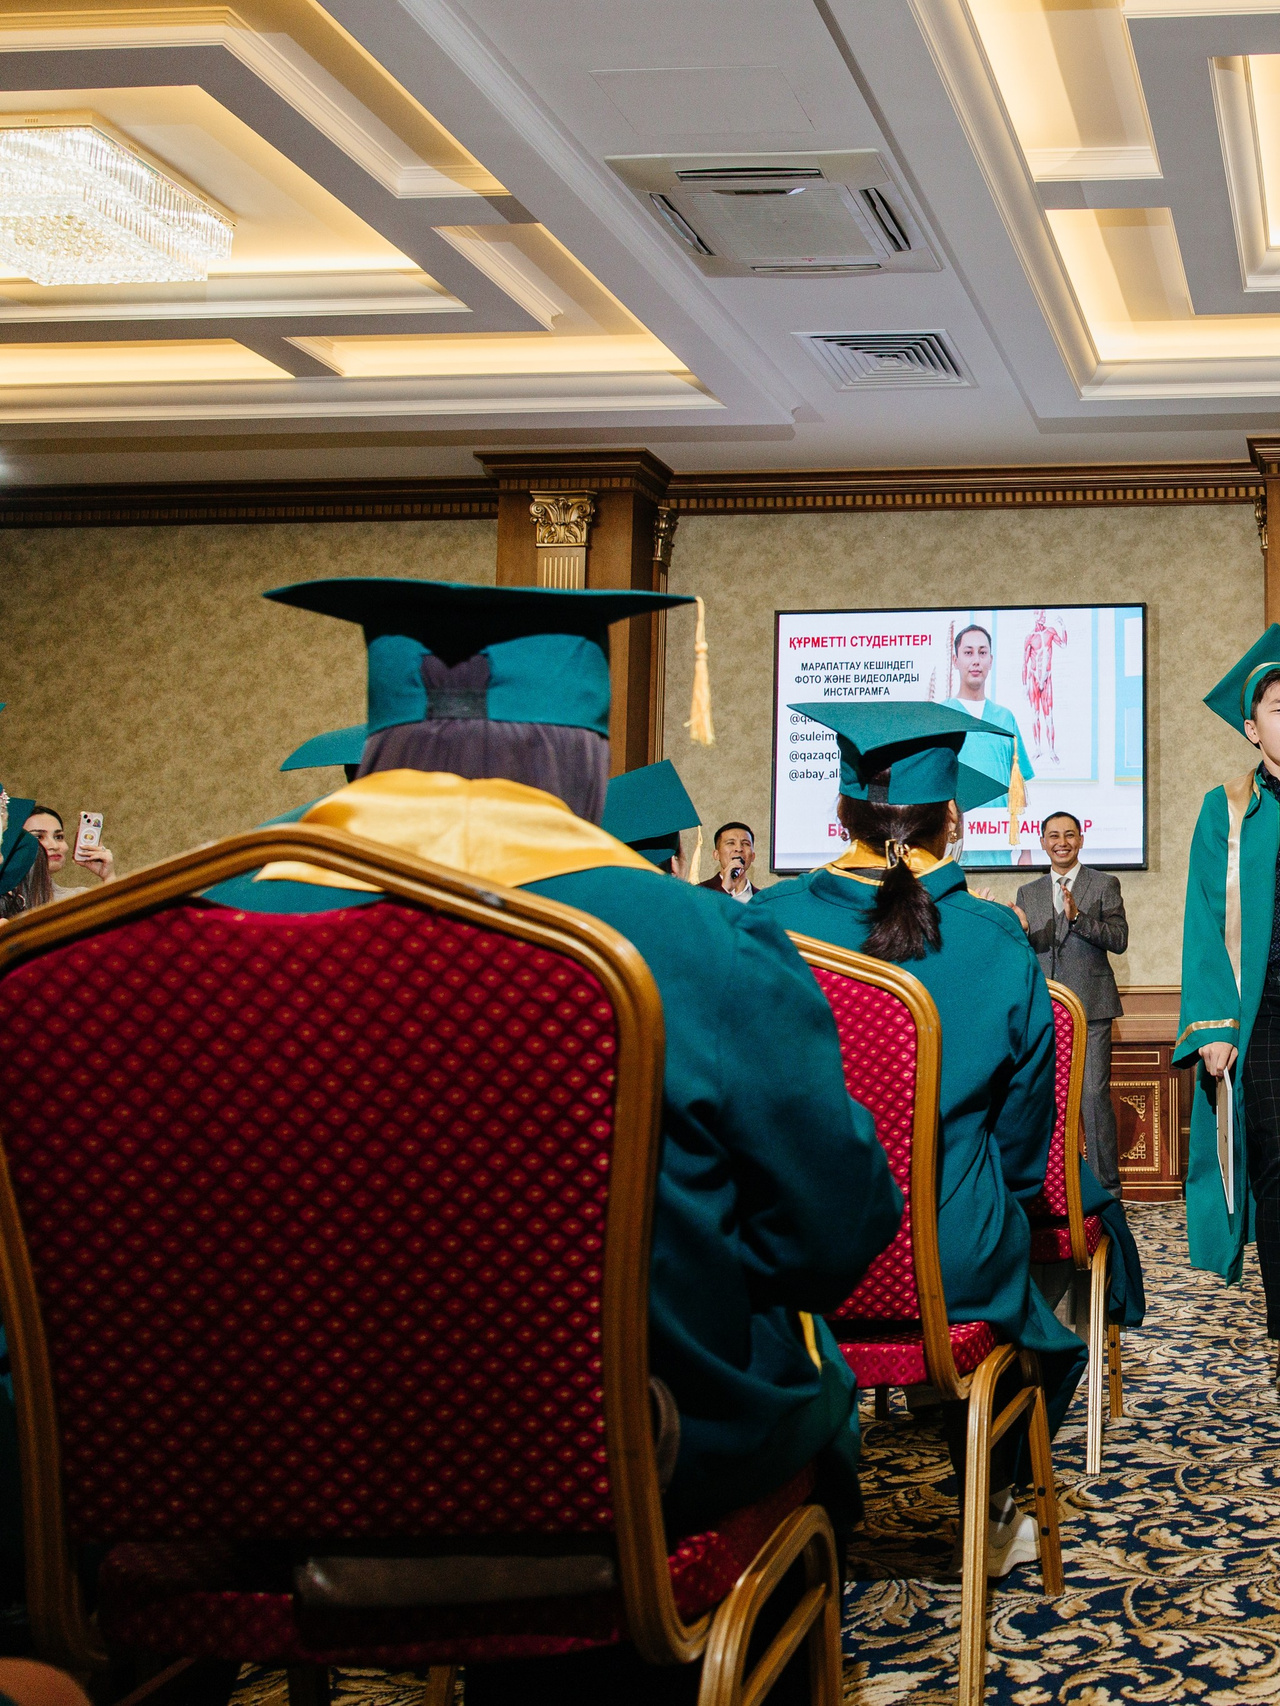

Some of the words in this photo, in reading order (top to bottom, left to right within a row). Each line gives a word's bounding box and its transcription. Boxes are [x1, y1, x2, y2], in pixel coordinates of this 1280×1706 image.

[789, 636, 847, 650] ҚҰРМЕТТІ
[850, 634, 932, 649] СТУДЕНТТЕР!
[800, 661, 861, 671] МАРАПАТТАУ
[863, 660, 914, 671] КЕШІНДЕГІ
[794, 674, 822, 684] ФОТО
[824, 674, 851, 684] ЖӘНЕ
[853, 673, 920, 684] ВИДЕОЛАРДЫ
[823, 686, 890, 697] ИНСТАГРАМҒА
[789, 731, 838, 744] @suleim
[788, 768, 841, 781] @abay_al
